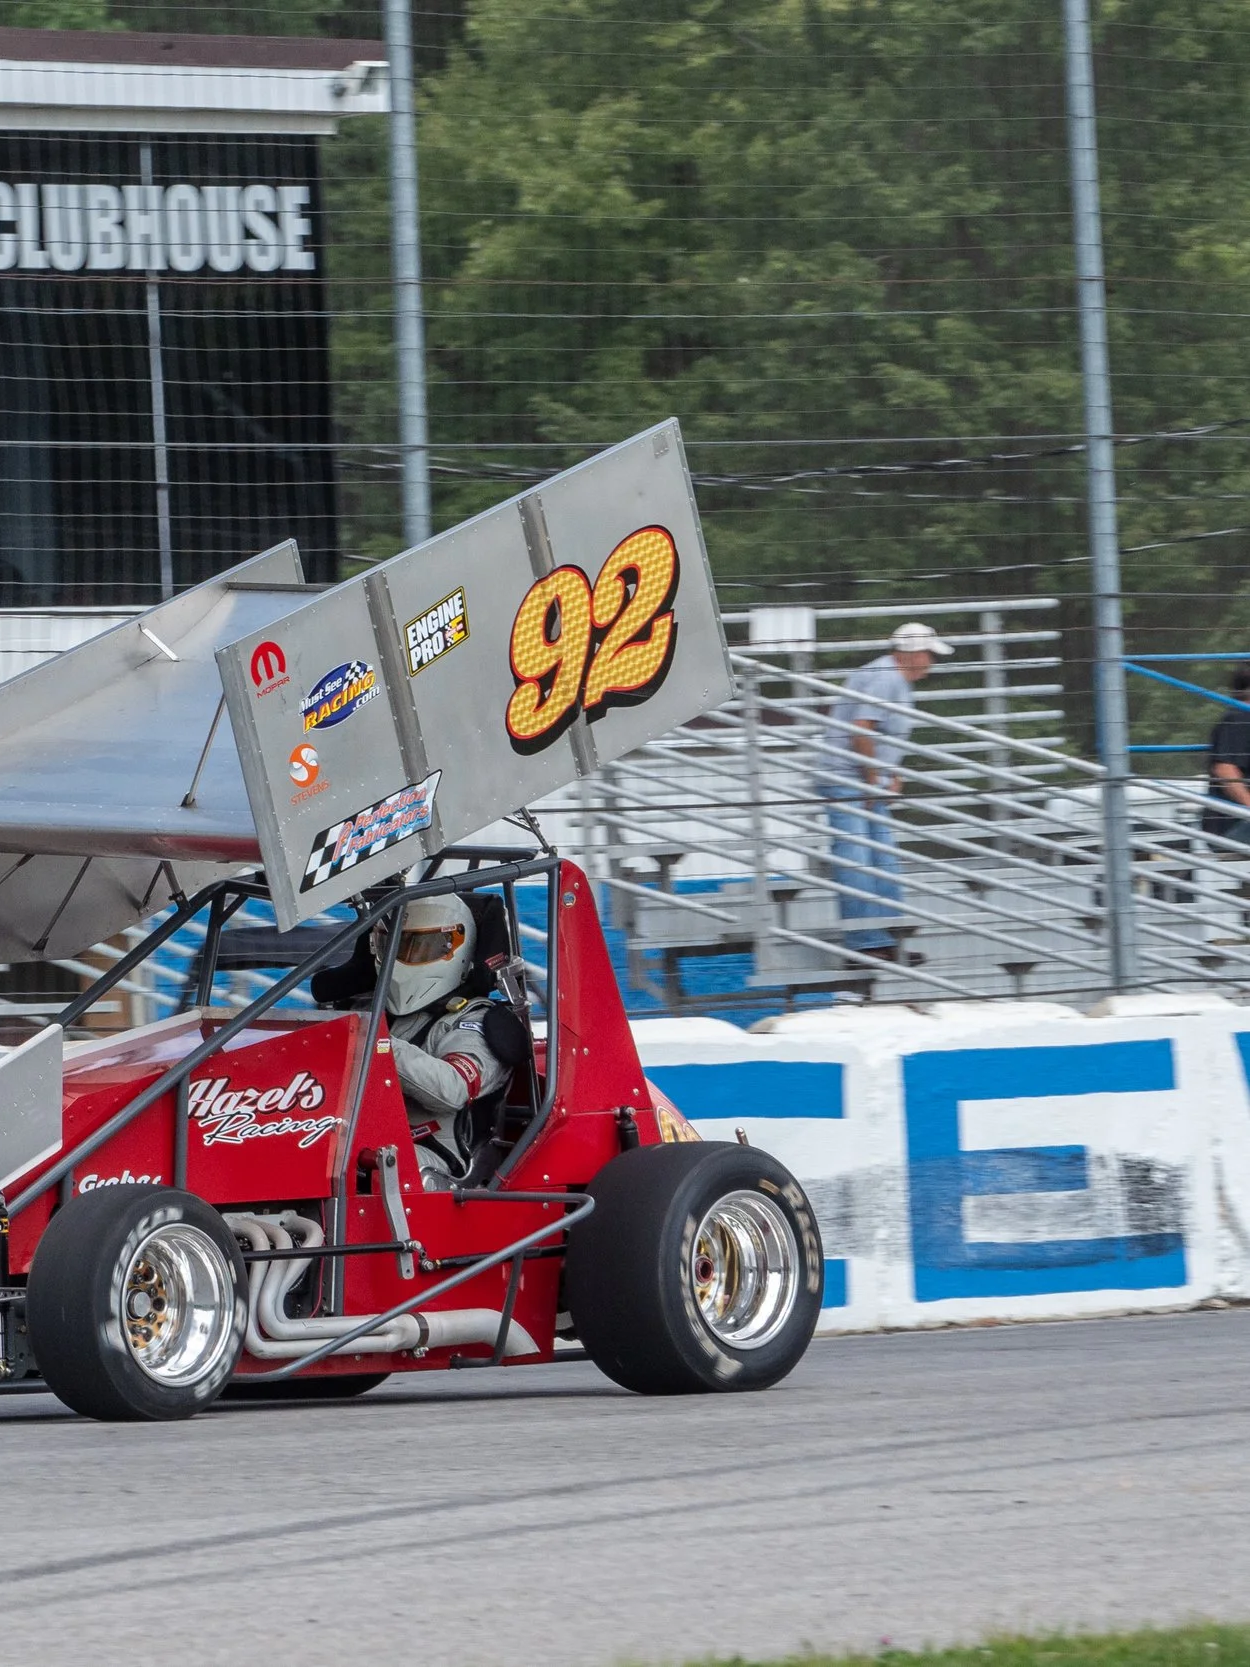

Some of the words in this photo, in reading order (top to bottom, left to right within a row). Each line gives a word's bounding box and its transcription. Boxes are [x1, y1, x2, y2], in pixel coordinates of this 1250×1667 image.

[407, 592, 464, 649] ENGINE
[506, 525, 679, 755] 92
[410, 630, 445, 672] PRO
[256, 676, 291, 699] MOPAR
[299, 687, 324, 712] Must
[324, 676, 343, 696] See
[303, 670, 377, 734] RACING
[352, 685, 381, 712] .com
[290, 778, 330, 806] STEVENS
[353, 787, 428, 832] Perfection
[347, 803, 430, 855] Fabricators
[188, 1071, 326, 1118] Hazel's
[198, 1112, 348, 1148] Racing
